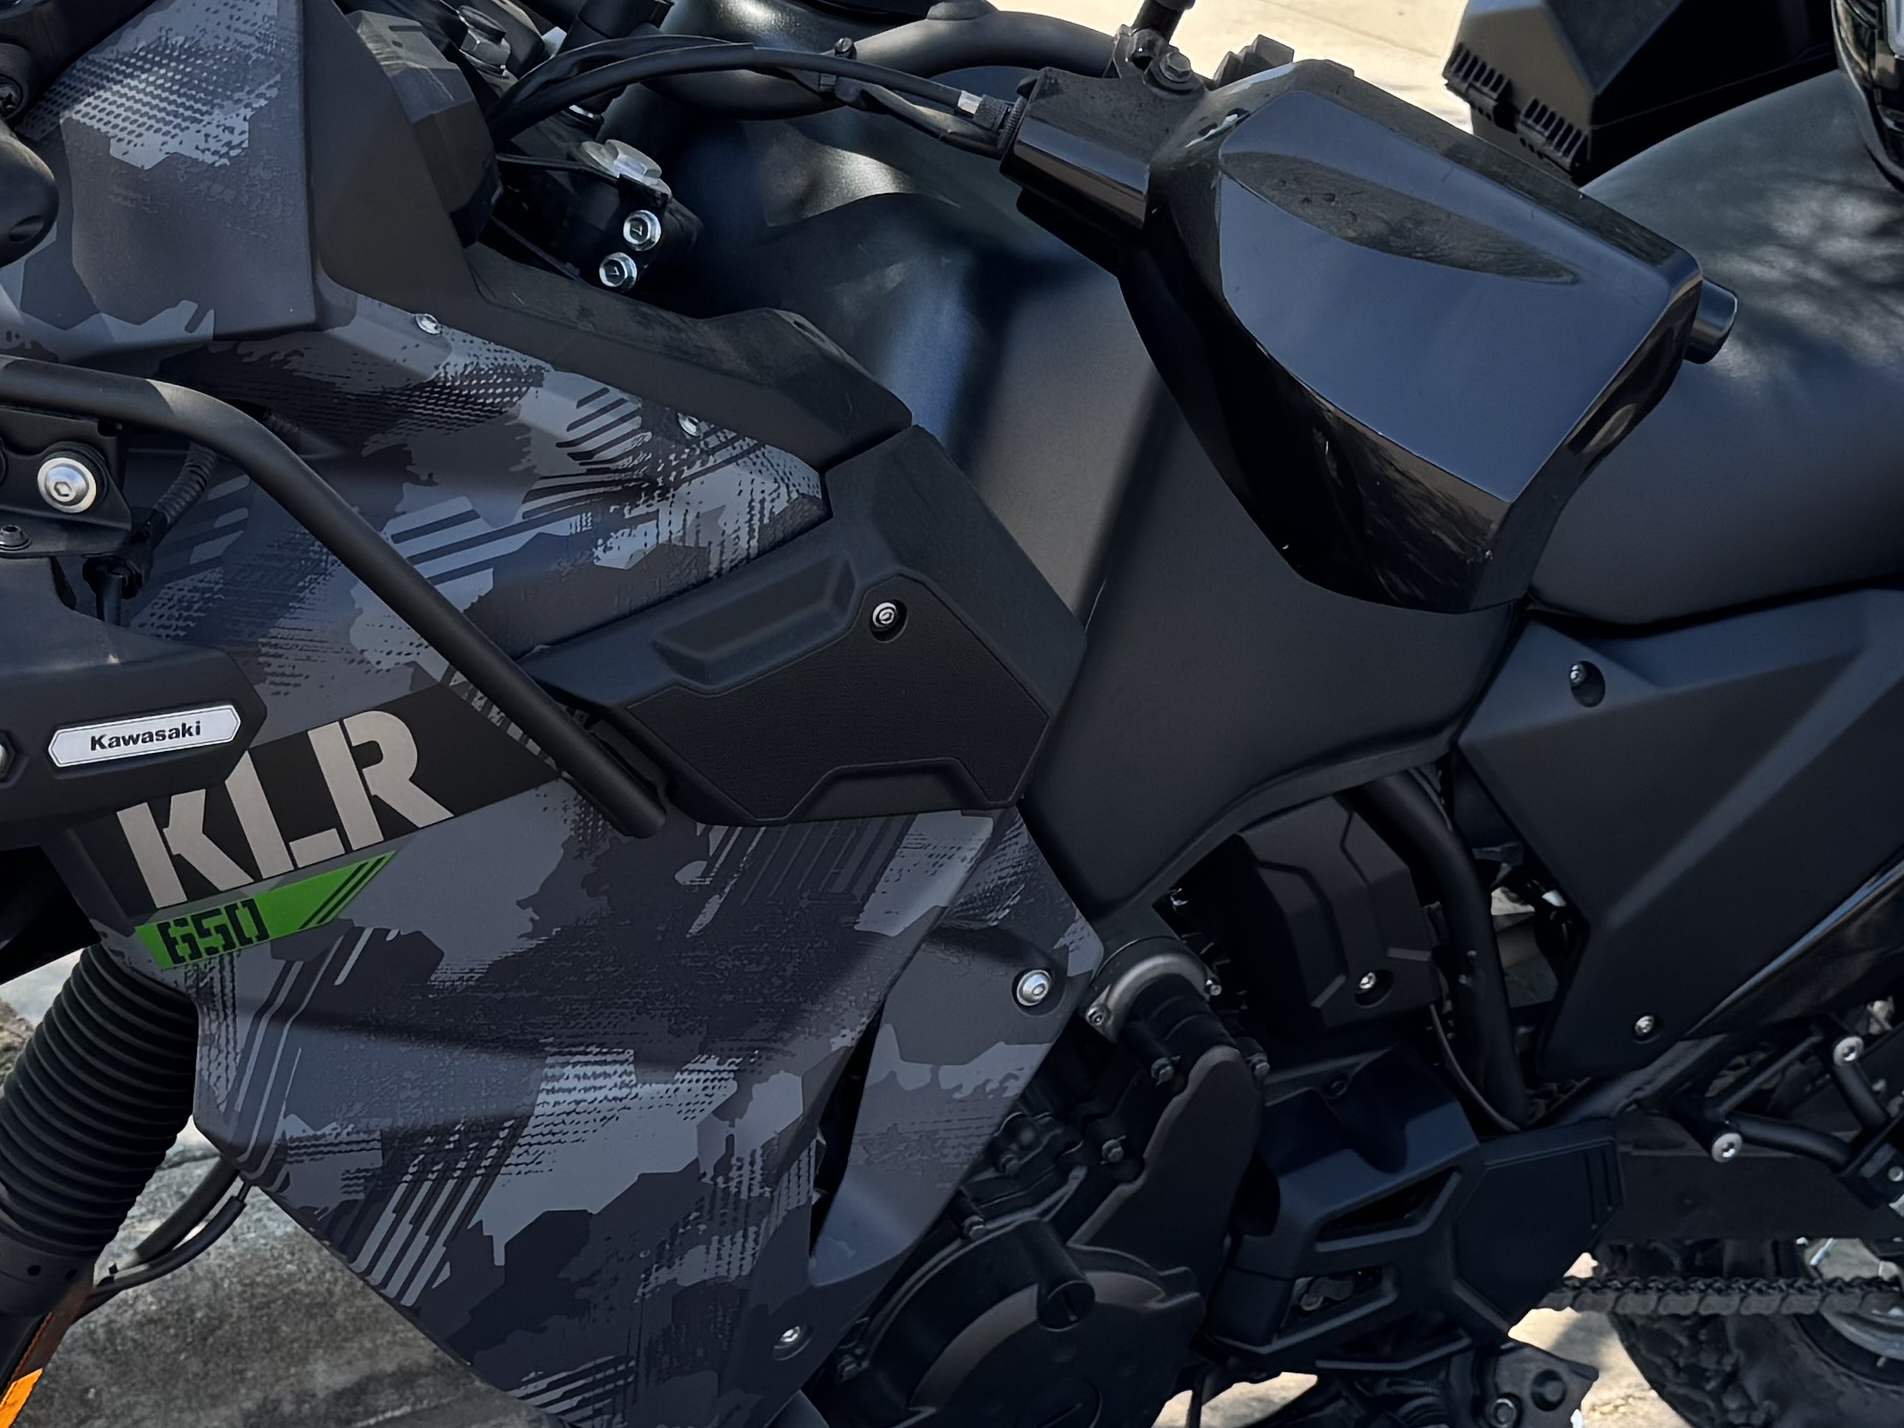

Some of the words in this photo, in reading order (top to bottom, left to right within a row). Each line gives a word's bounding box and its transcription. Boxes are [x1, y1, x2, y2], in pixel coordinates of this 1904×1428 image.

[89, 719, 202, 752] Kawasaki
[116, 709, 455, 909] KLR
[155, 897, 271, 966] 650
